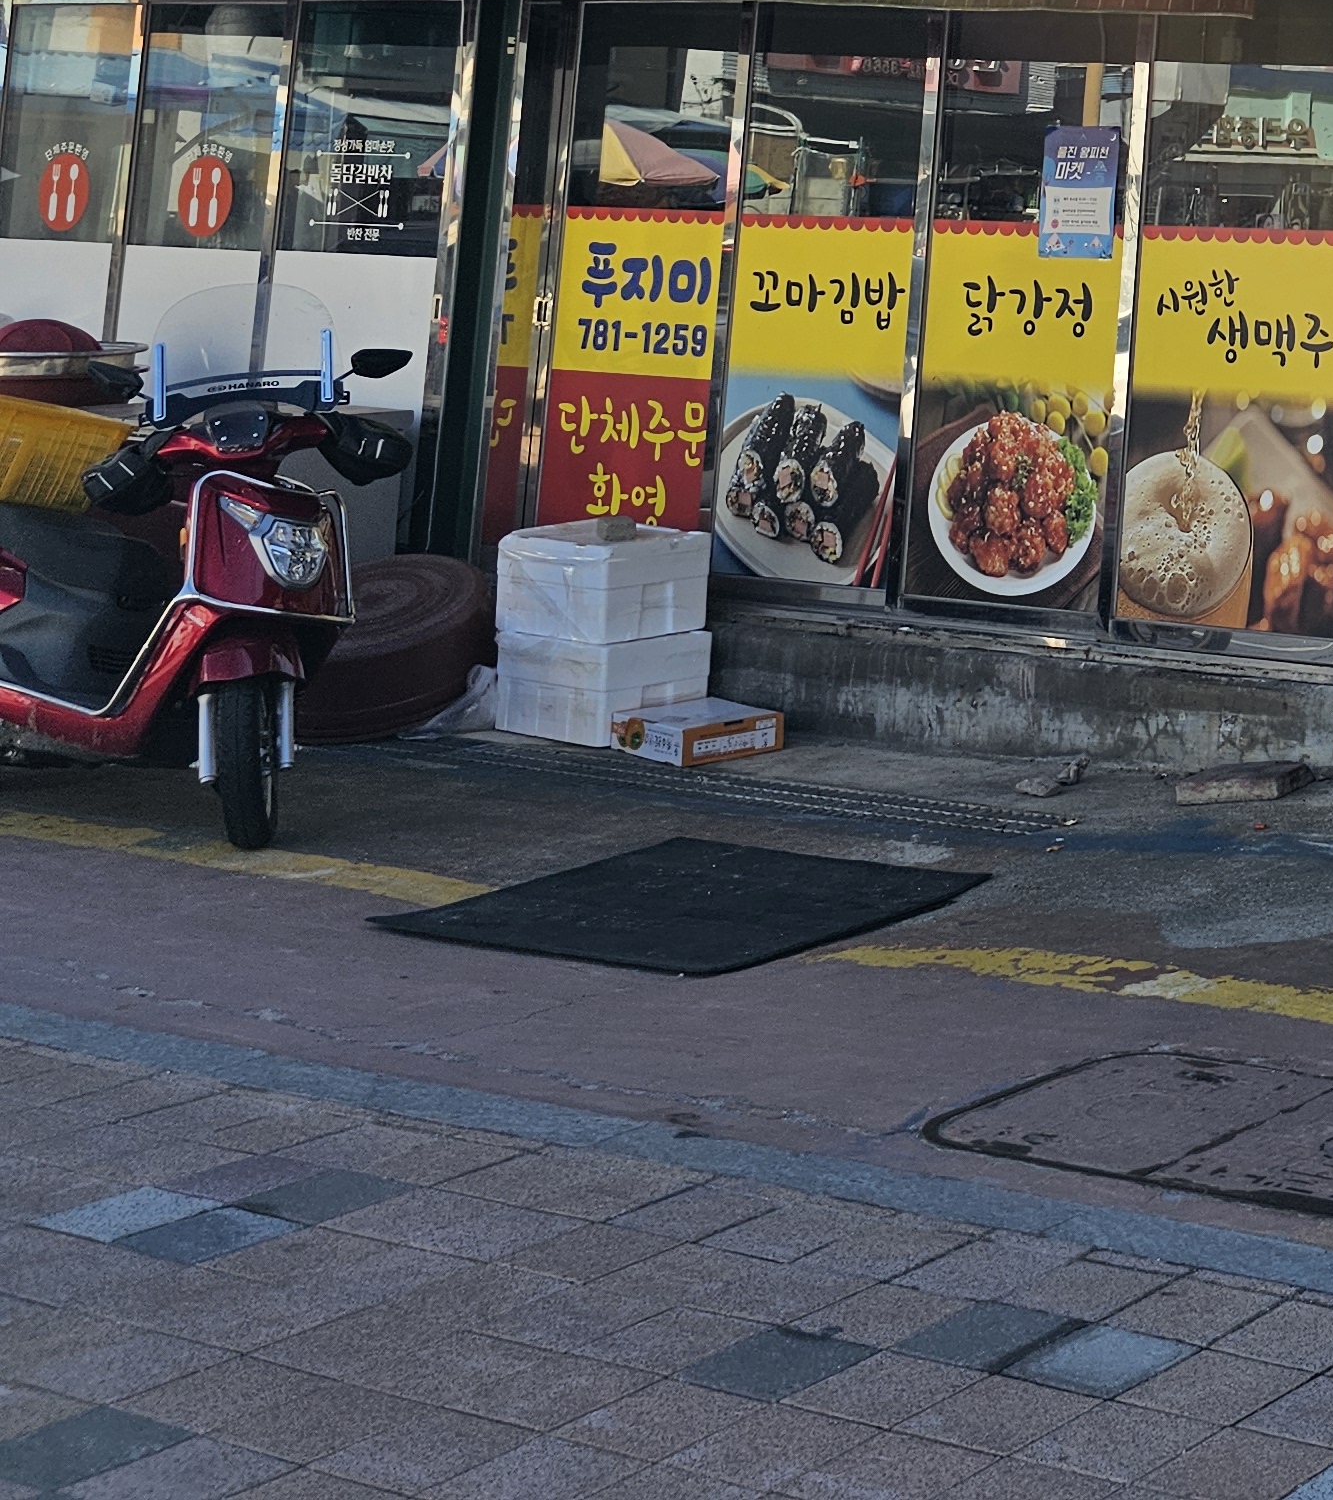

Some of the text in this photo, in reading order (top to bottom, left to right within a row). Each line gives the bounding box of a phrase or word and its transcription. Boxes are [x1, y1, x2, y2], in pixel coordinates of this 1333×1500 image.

[330, 163, 393, 185] 돌담길반찬
[347, 228, 363, 241] 반찬
[750, 270, 907, 331] 꼬마김밥
[963, 275, 1095, 338] 닭강정
[1155, 269, 1240, 316] 시원한
[578, 318, 708, 357] 781-1259
[228, 380, 280, 390] HANARO
[558, 395, 707, 467] 단체주문
